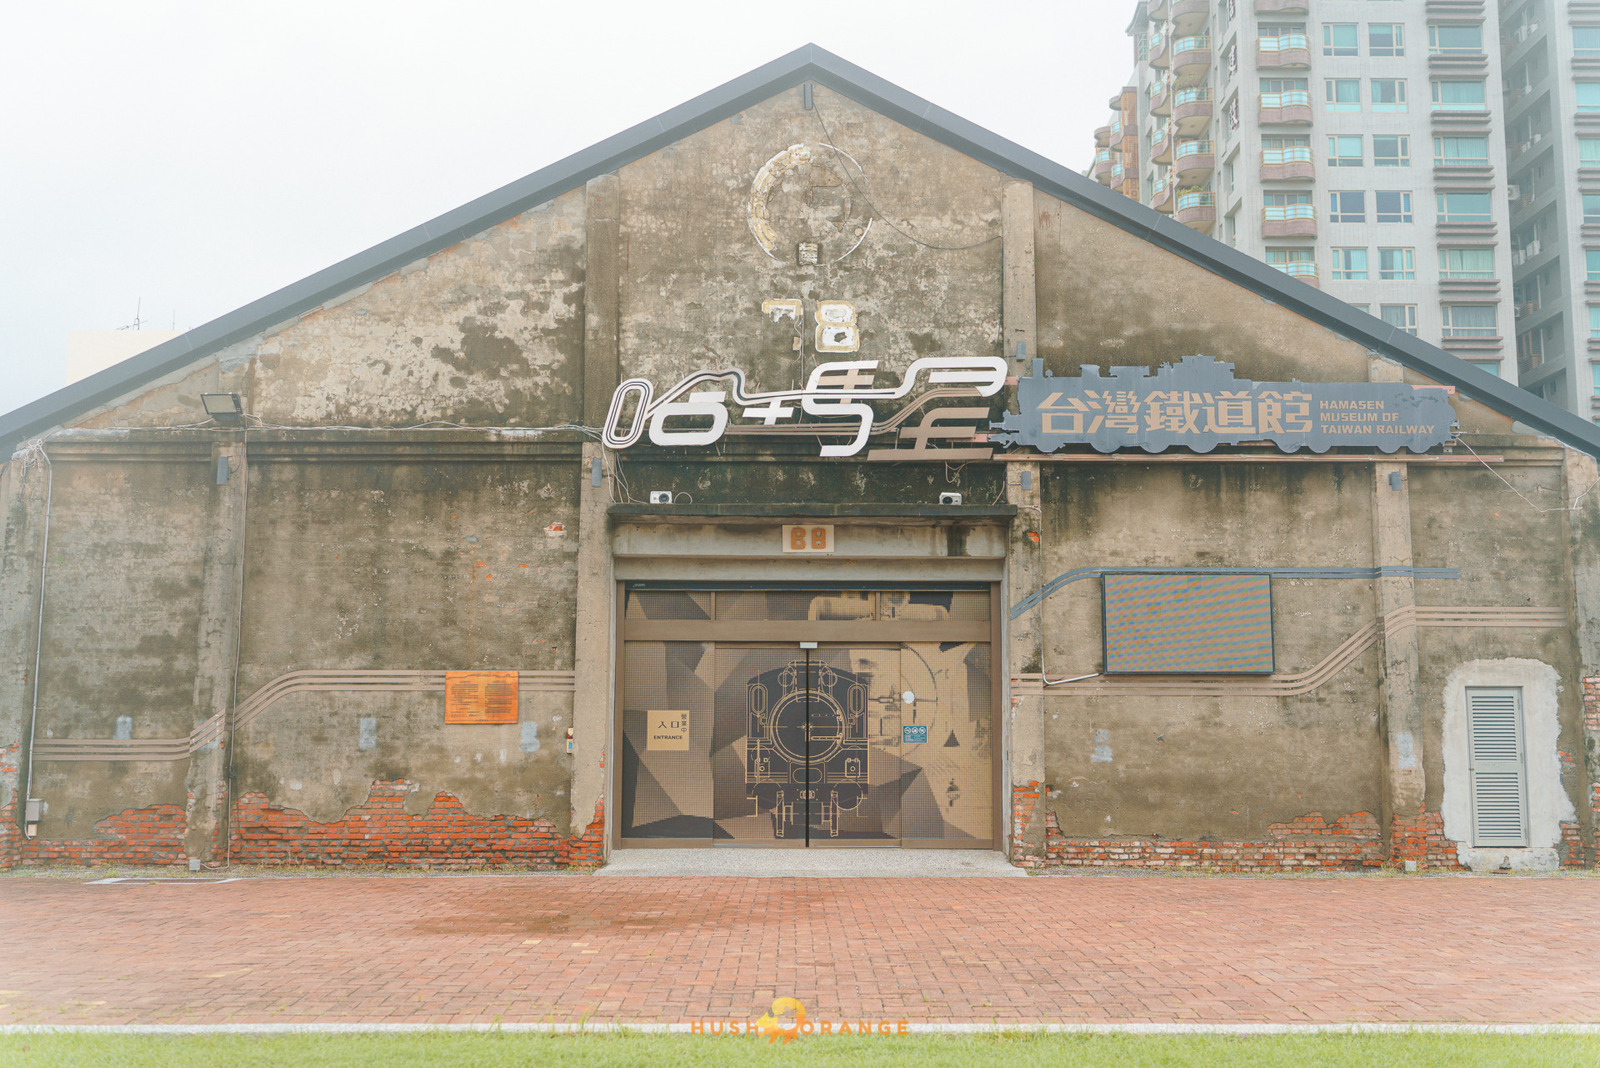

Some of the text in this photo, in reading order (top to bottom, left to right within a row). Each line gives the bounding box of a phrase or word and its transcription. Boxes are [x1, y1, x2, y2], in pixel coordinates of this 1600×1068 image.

[1319, 400, 1385, 410] HAMASEN
[1037, 389, 1313, 435] 台灣鐵道館
[1320, 412, 1399, 422] MUSEUM OF
[1321, 425, 1435, 434] TAIWAN RAILWAY
[658, 720, 679, 728] 入口
